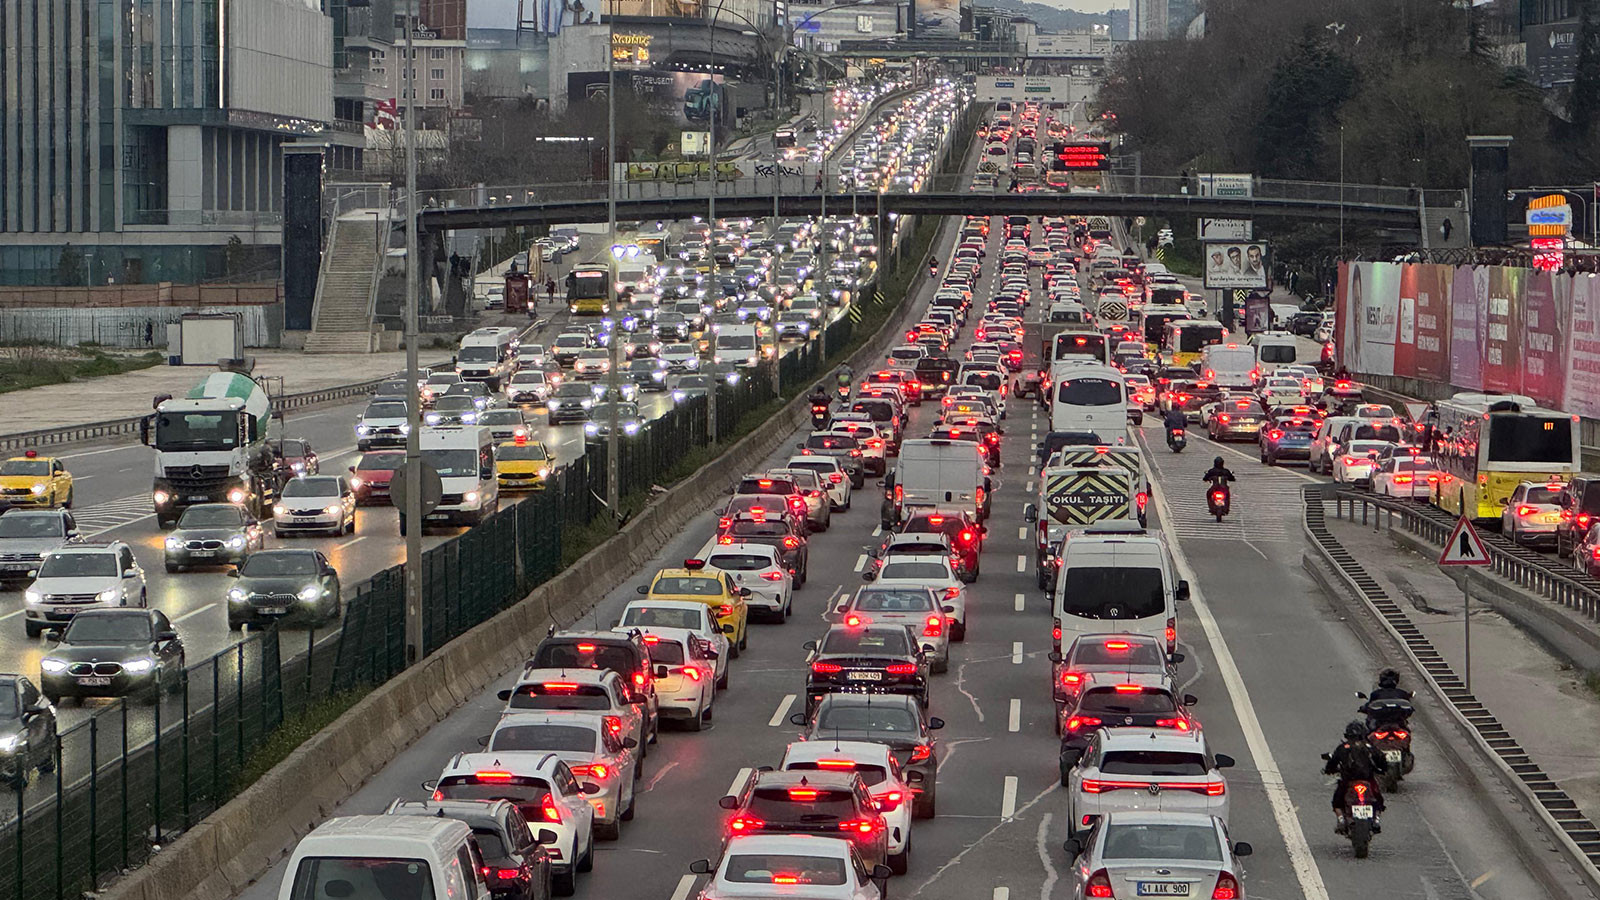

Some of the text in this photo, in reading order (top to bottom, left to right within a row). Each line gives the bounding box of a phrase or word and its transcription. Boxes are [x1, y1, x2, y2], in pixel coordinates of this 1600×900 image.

[643, 76, 674, 85] PEUGEOT
[1052, 496, 1124, 505] OKUL TAŞITI
[1142, 882, 1187, 894] 41 AAK 900
